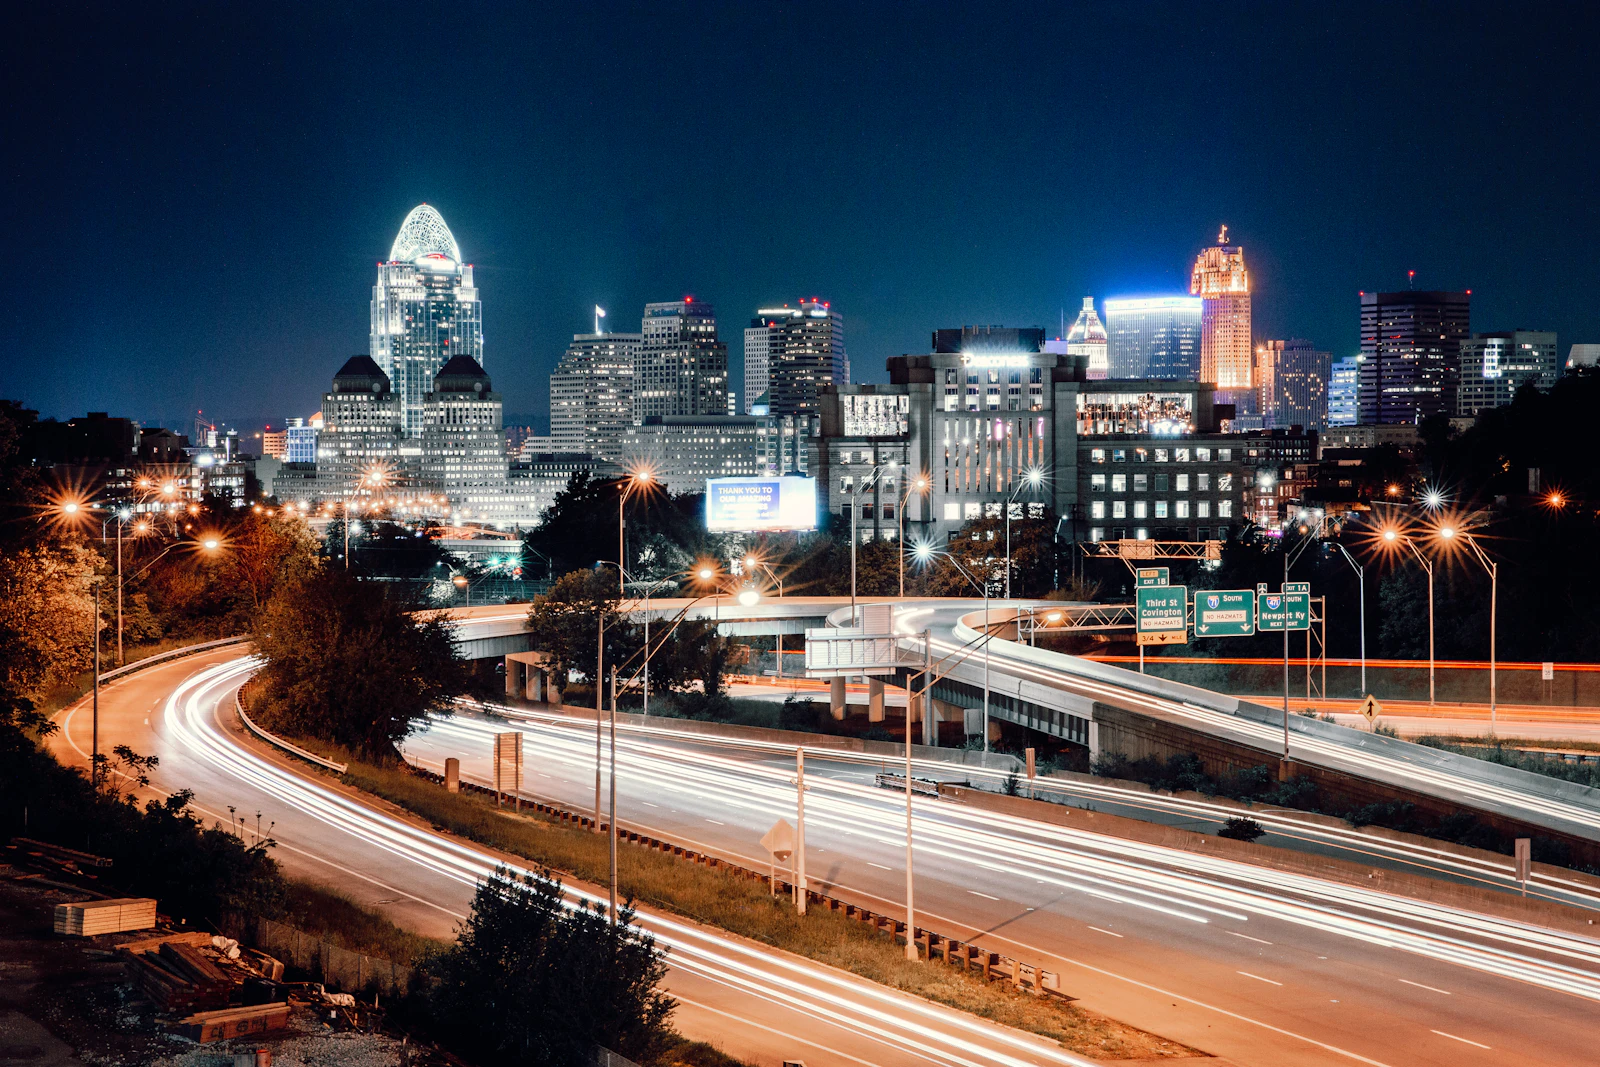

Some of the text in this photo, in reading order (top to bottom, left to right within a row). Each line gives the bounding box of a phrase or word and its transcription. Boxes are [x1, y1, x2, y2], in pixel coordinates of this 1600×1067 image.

[1146, 599, 1167, 607] Third
[1142, 609, 1182, 617] Covington
[1296, 612, 1305, 620] Ky
